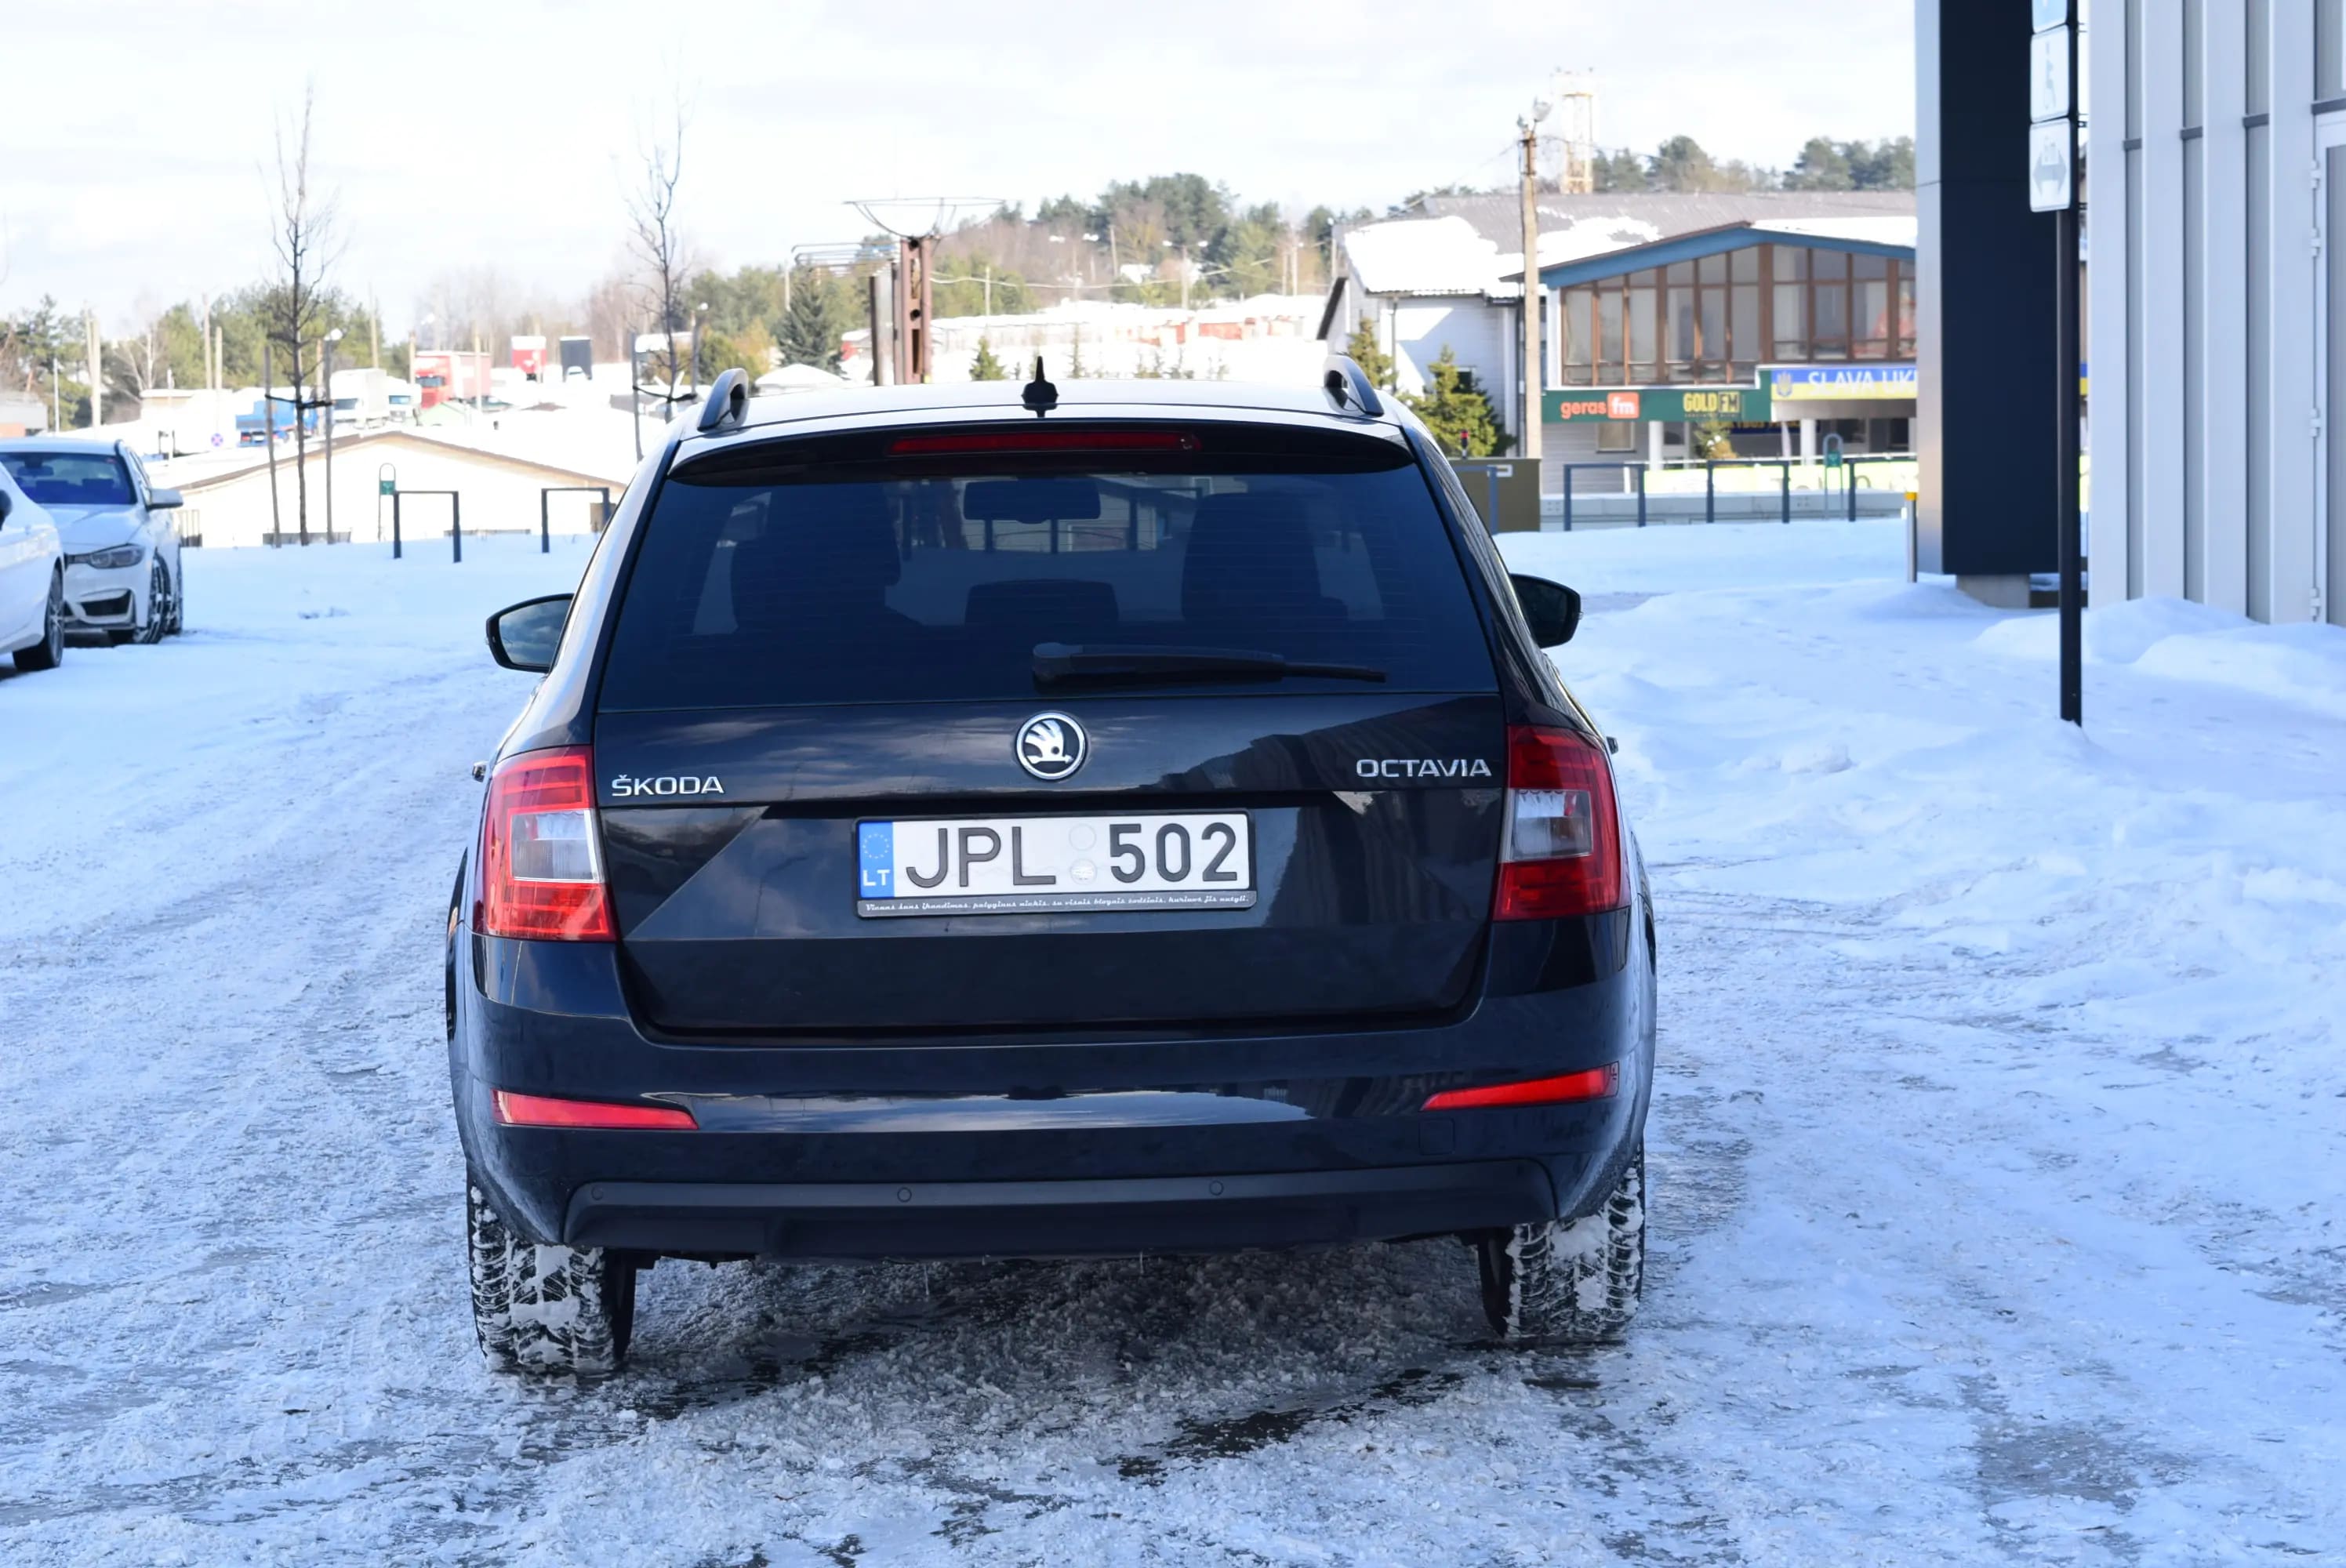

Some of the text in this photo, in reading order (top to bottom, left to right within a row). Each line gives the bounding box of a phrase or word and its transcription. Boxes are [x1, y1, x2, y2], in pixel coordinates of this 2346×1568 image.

[1808, 369, 1917, 395] SLAVA UK
[1560, 396, 1636, 419] geras fm
[1683, 392, 1739, 412] GOLD FM
[1356, 758, 1492, 778] OCTAVIA
[612, 774, 724, 797] ŠKODA
[906, 821, 1239, 889] JPL 502
[862, 869, 891, 887] LT
